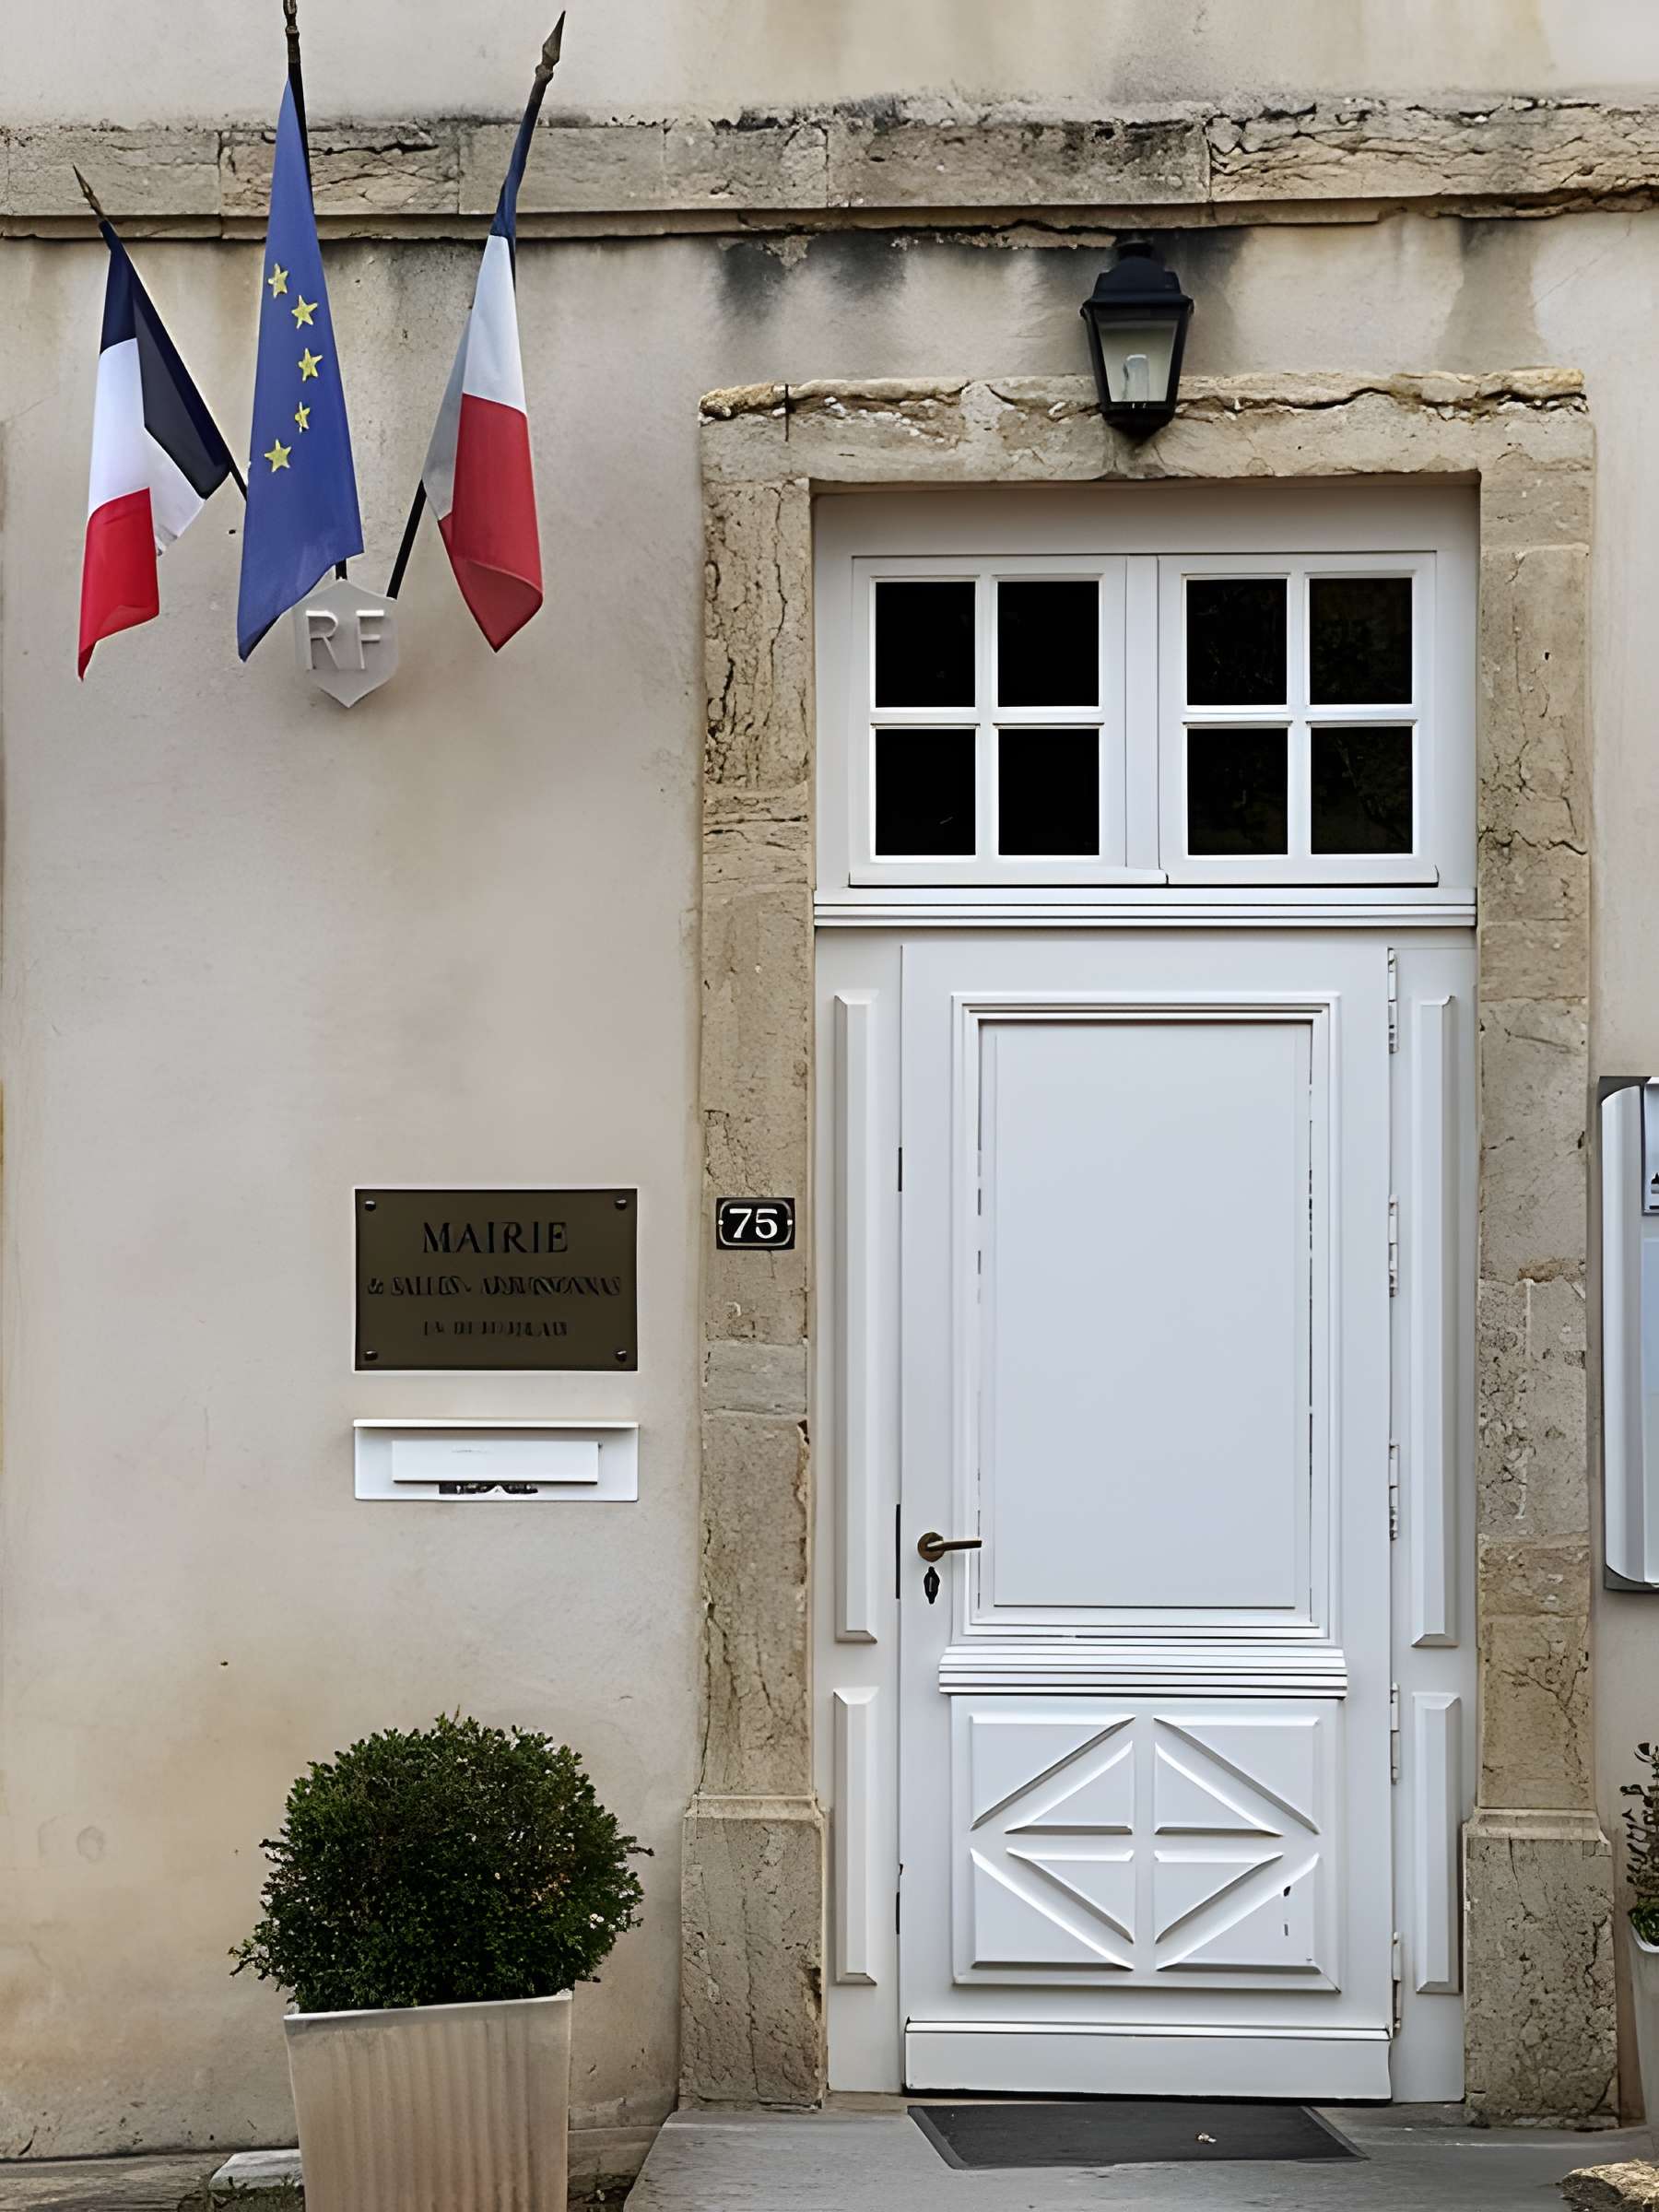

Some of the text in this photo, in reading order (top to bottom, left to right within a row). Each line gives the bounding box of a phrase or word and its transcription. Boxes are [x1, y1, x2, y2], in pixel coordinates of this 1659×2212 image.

[305, 609, 384, 670] RF
[422, 1221, 569, 1253] MAIRIE
[729, 1208, 778, 1239] 75
